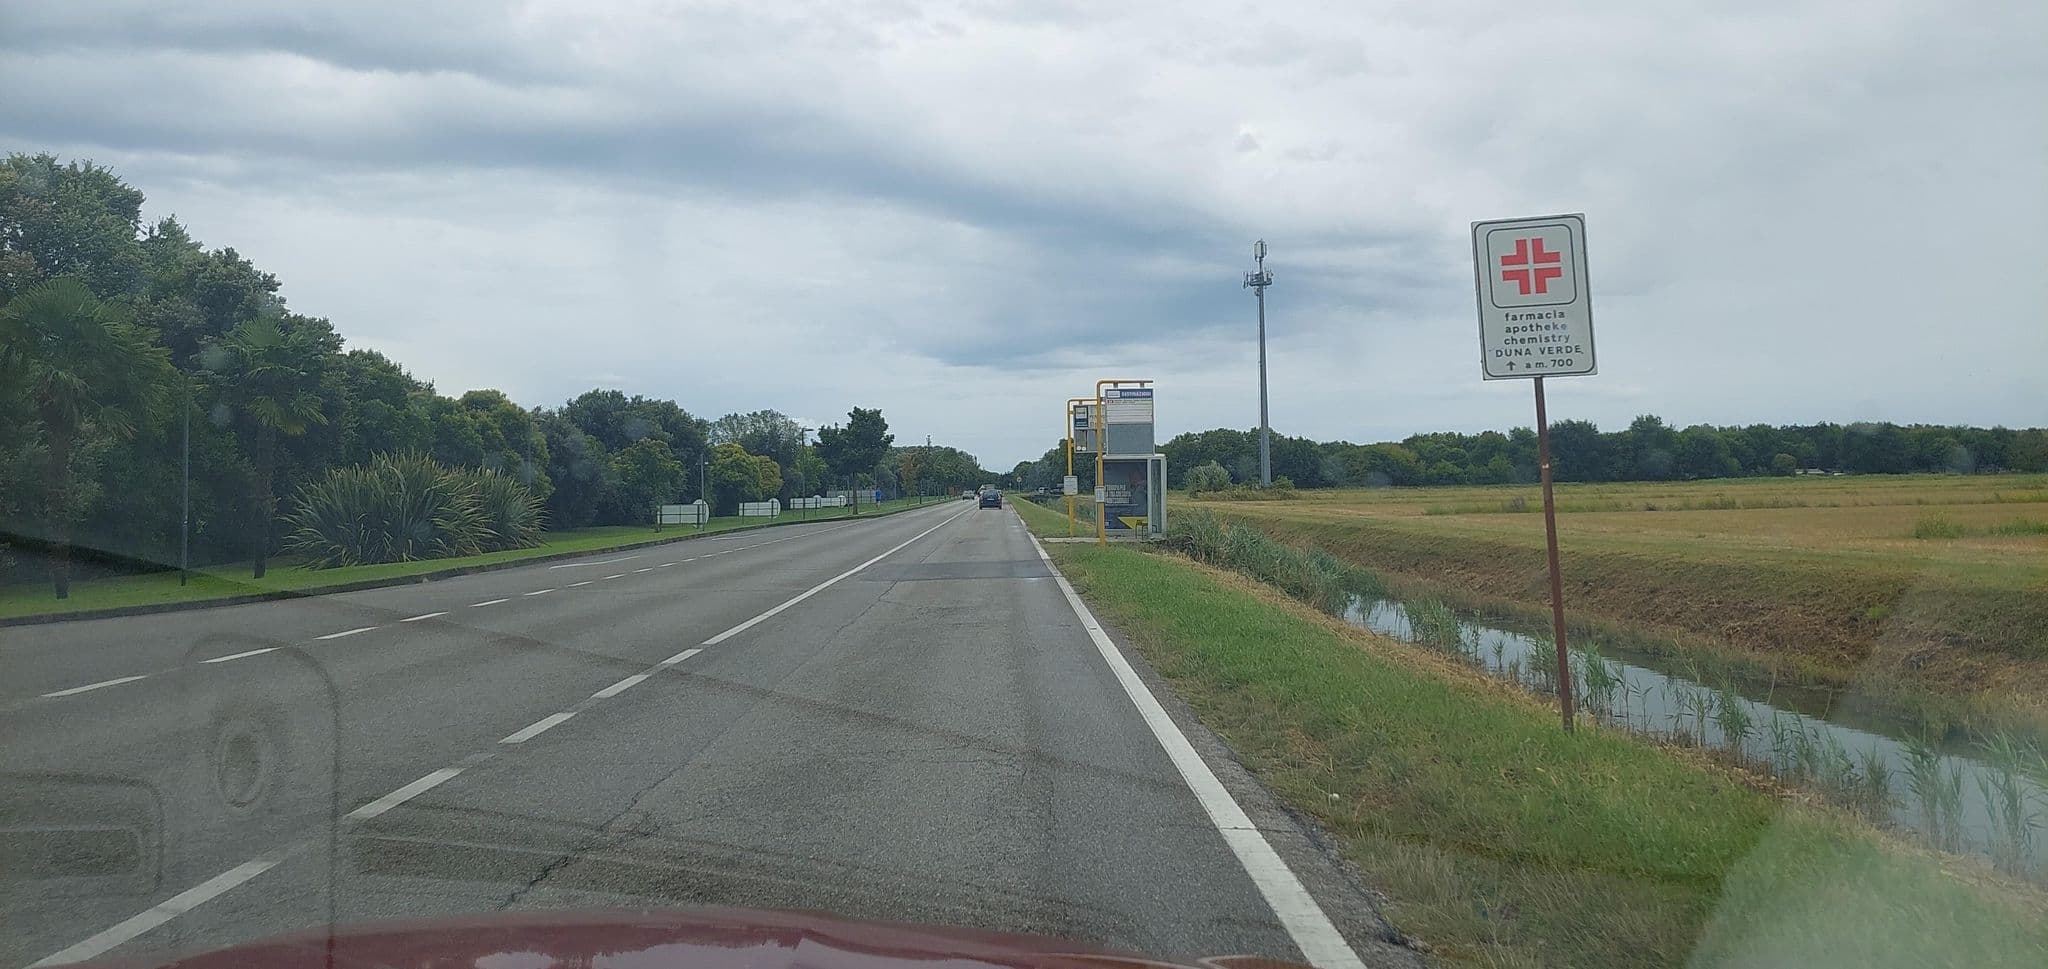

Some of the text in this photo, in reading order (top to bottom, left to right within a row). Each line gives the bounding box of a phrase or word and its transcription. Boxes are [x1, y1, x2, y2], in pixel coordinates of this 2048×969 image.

[1505, 310, 1565, 321] farmacia
[1505, 322, 1567, 334] apotheke
[1504, 334, 1570, 345] chemistry
[1495, 348, 1532, 358] DUNA
[1550, 358, 1573, 367] 700
